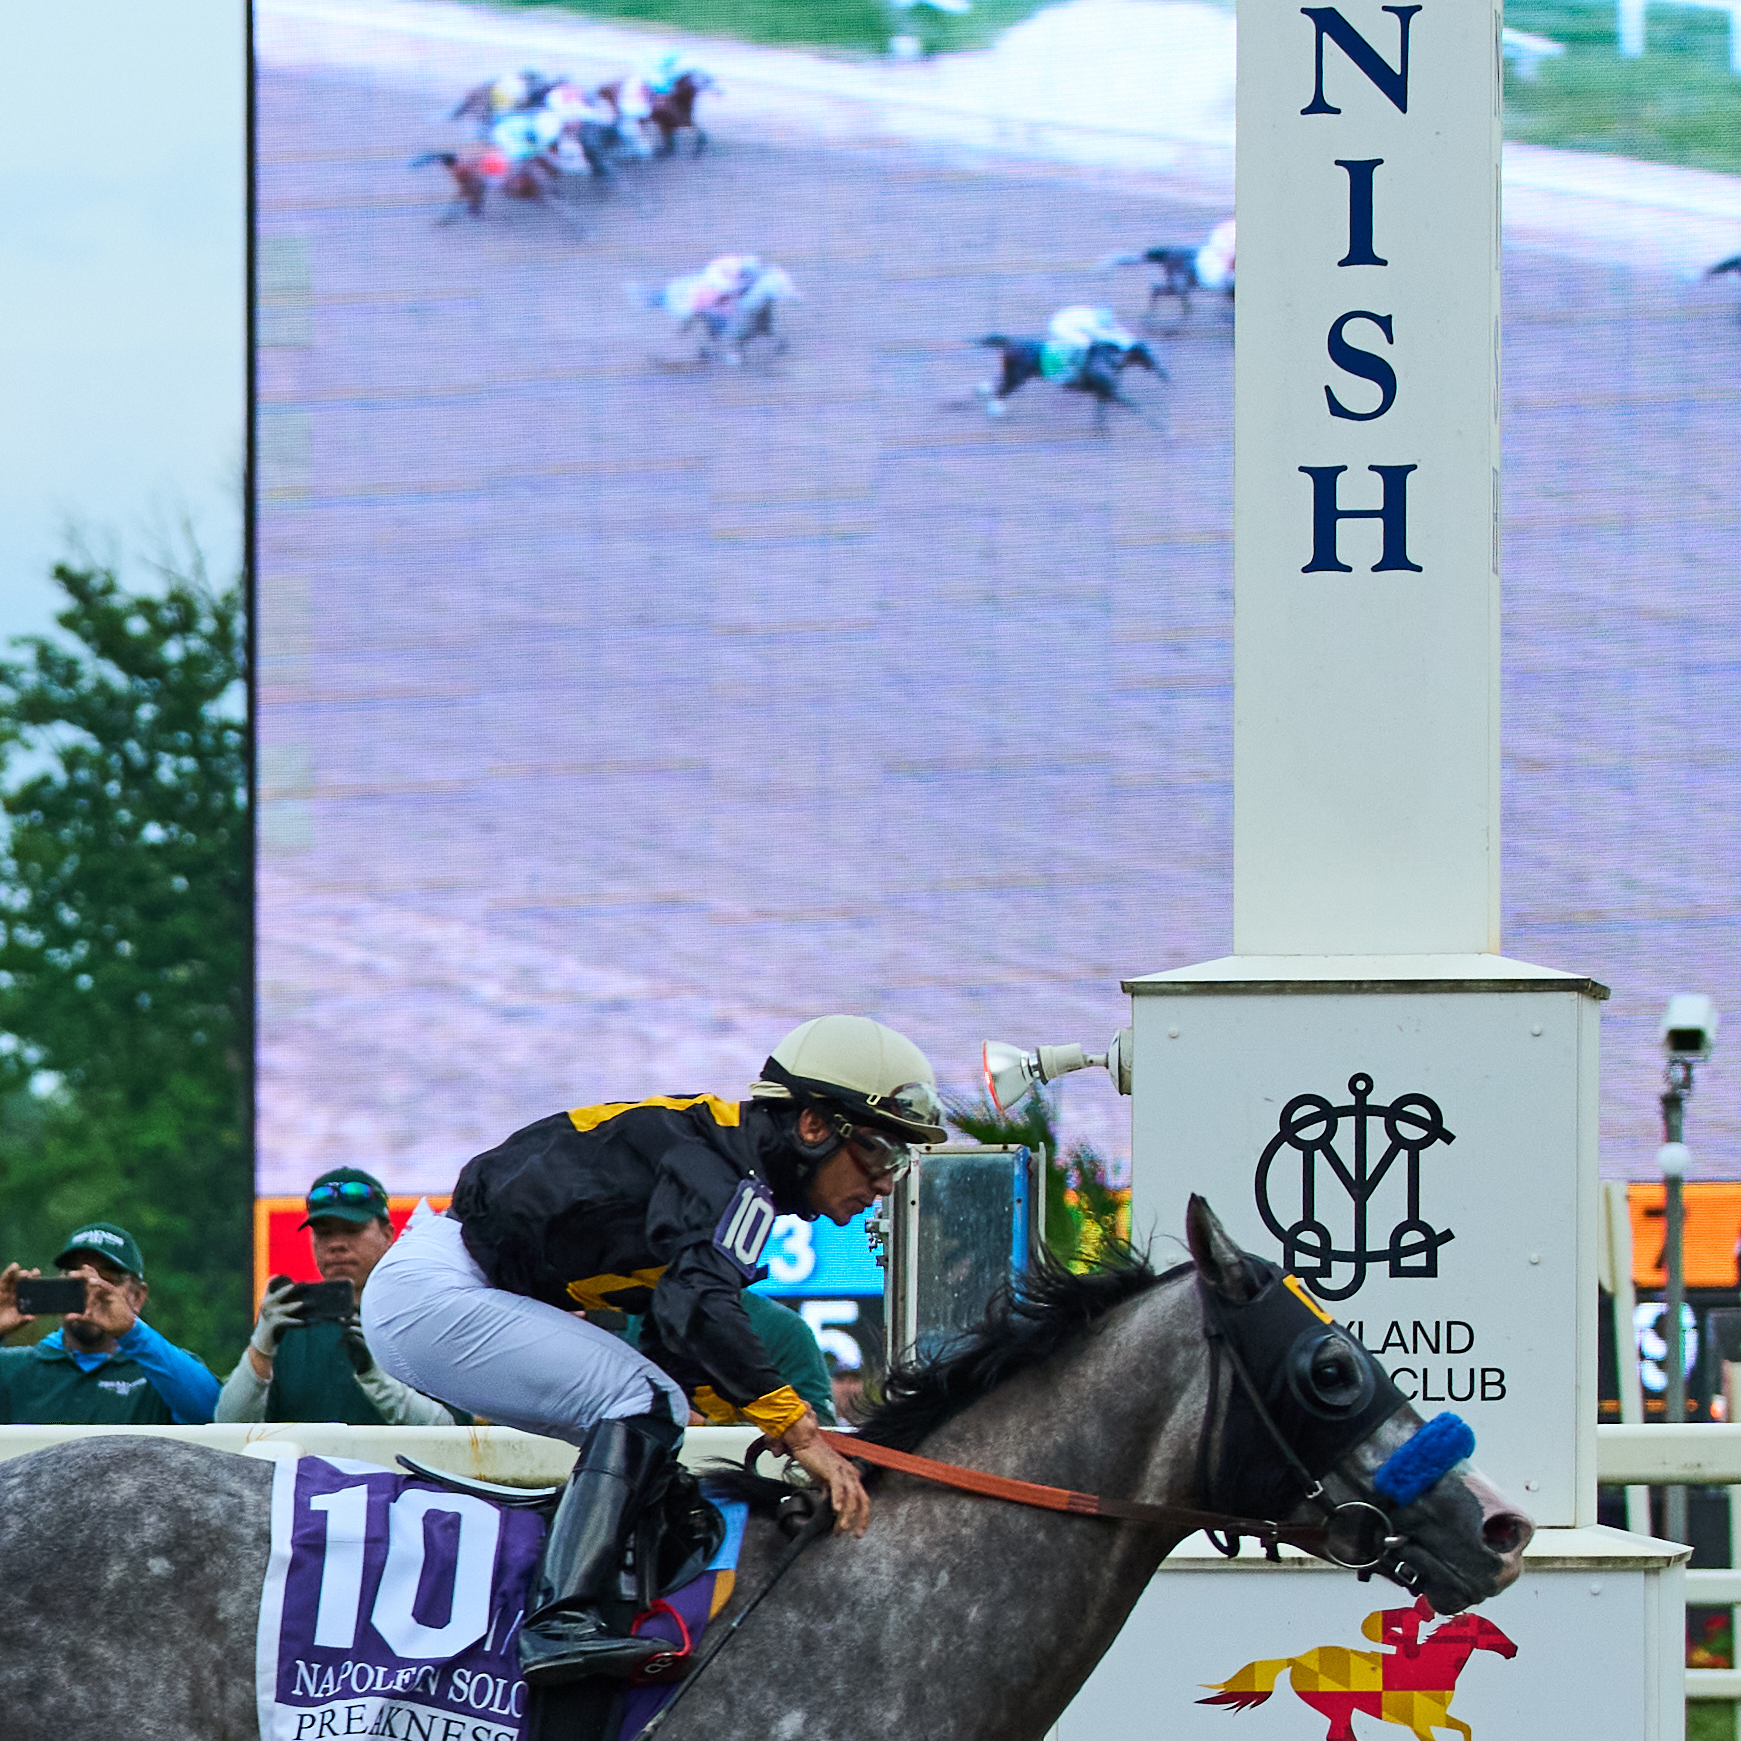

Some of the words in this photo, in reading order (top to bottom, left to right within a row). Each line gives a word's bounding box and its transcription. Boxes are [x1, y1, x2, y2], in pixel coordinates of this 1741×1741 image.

[721, 1186, 775, 1265] 10
[768, 1213, 816, 1283] 3
[799, 1300, 862, 1370] 5
[1390, 1367, 1507, 1402] CLUB
[310, 1484, 501, 1659] 10
